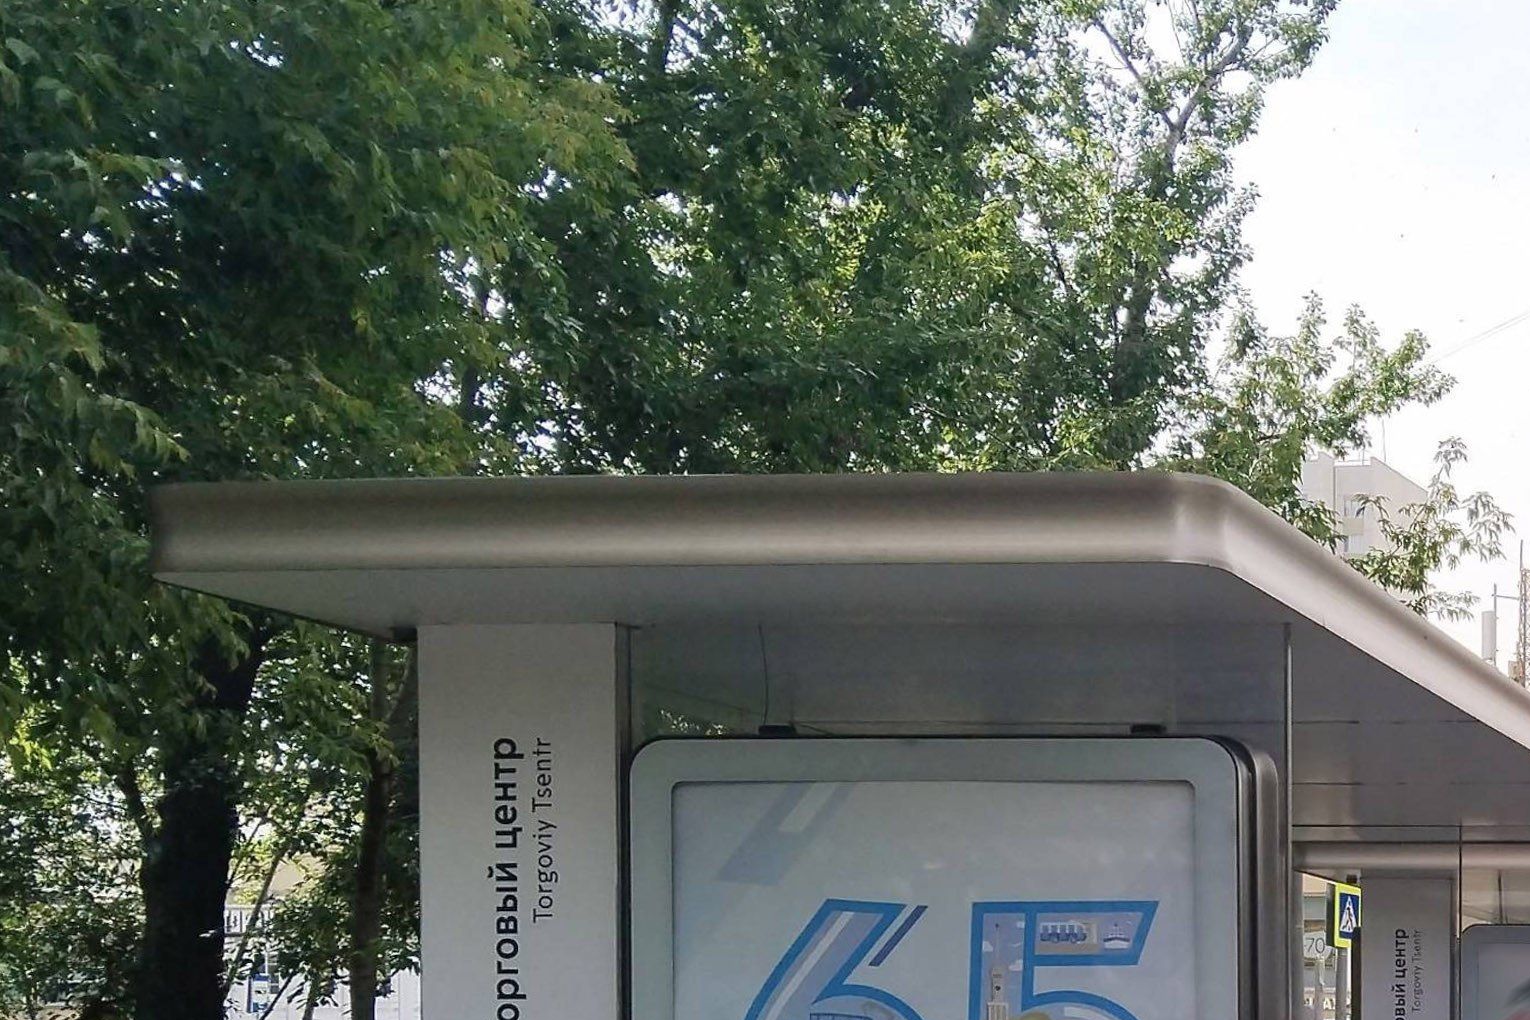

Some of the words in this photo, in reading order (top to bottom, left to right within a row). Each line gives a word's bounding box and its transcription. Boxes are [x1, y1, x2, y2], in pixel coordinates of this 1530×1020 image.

[493, 737, 525, 849] центр
[531, 737, 553, 813] Tsentr
[532, 818, 559, 923] Torgoviy
[1395, 928, 1410, 978] центр
